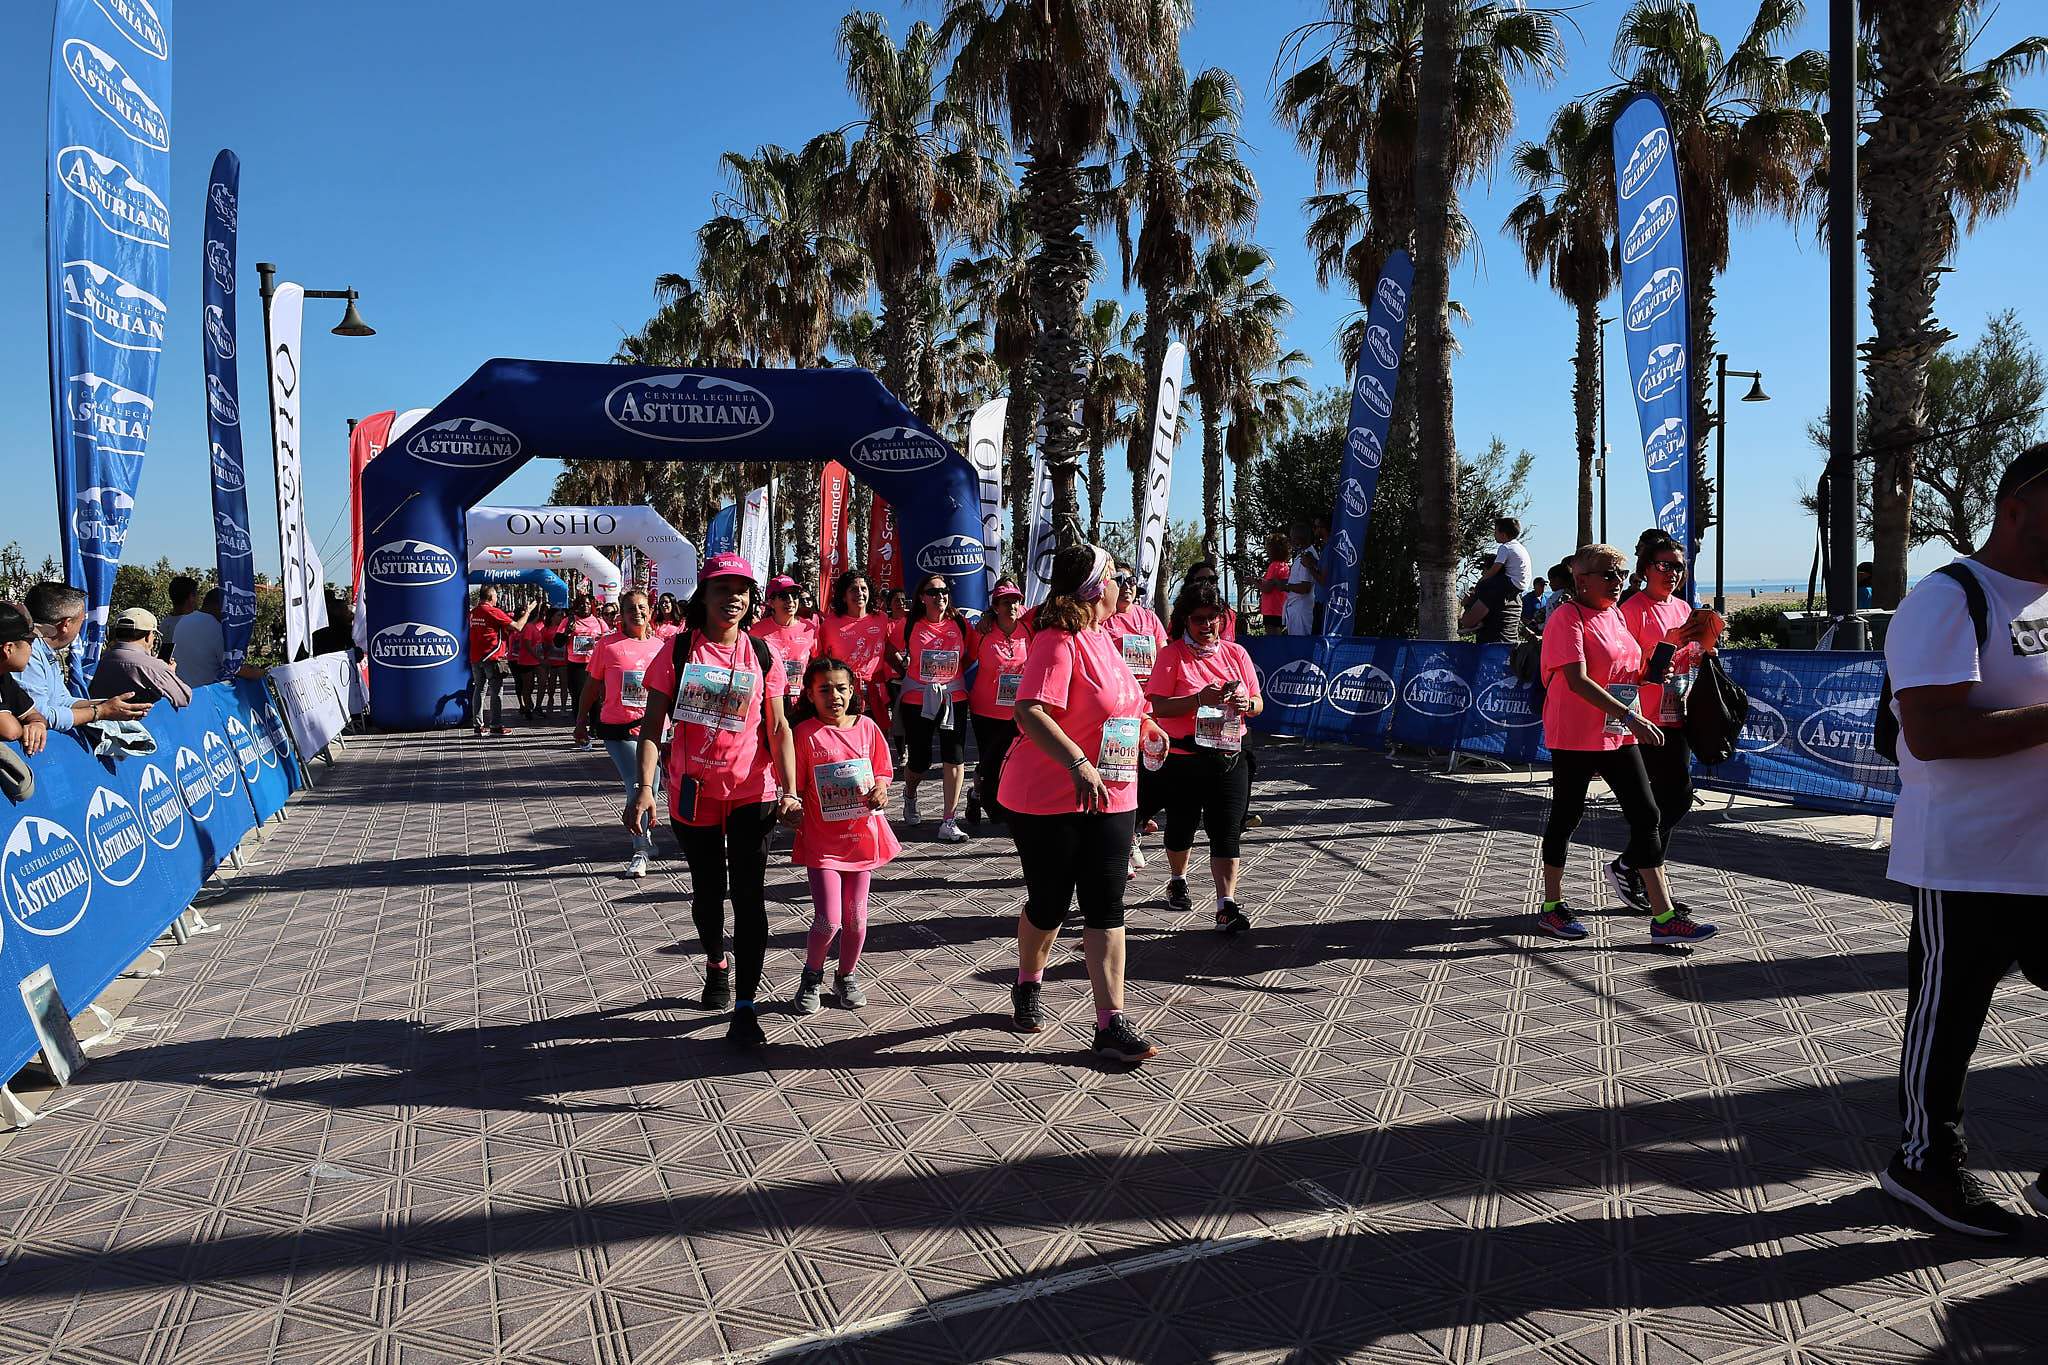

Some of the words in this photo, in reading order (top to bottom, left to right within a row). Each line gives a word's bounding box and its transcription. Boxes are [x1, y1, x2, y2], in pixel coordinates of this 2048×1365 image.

[110, 0, 164, 56] URIANA
[72, 49, 166, 147] ASTURIANA
[66, 157, 170, 242] ASTURIANA
[64, 273, 164, 341] ASURIAN
[618, 392, 762, 425] ASTURIANA
[644, 391, 698, 400] CENTRAL
[703, 393, 755, 402] LECHERA
[1361, 383, 1390, 414] ASTURIANA
[413, 435, 512, 456] ASTURIANA
[858, 444, 942, 461] ASTURIANA
[1141, 376, 1175, 580] OYSHO
[507, 513, 616, 535] OYSHO
[829, 477, 841, 547] Santander
[647, 535, 677, 543] OYSHO
[372, 557, 452, 575] ASTURIANA
[374, 640, 453, 657] ASTURIANA
[1270, 677, 1321, 697] ASTURIANA
[1331, 680, 1388, 704] ASTURIANA
[144, 796, 181, 836] ASTURIANA
[20, 855, 50, 877] CENTRAL
[49, 842, 75, 862] LECHERA
[93, 823, 143, 871] ASTURIANA
[11, 857, 88, 921] ASTURIANA
